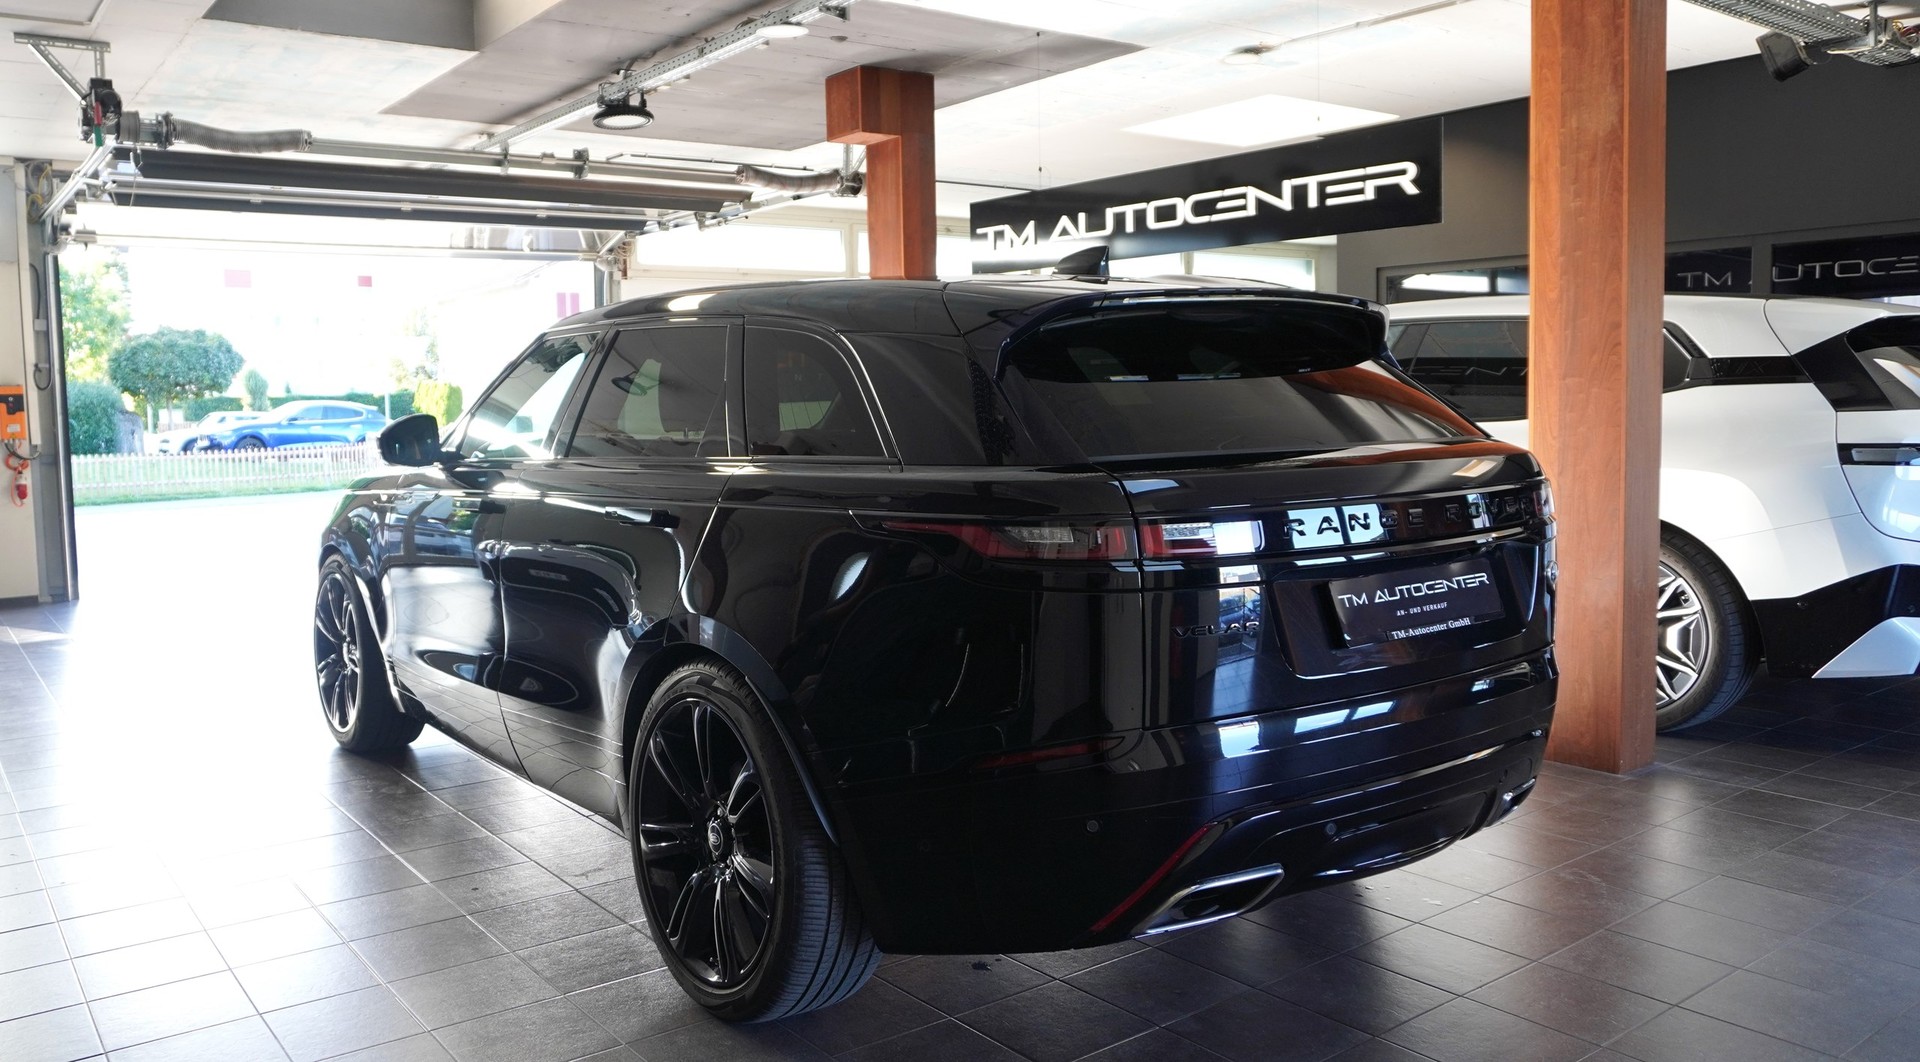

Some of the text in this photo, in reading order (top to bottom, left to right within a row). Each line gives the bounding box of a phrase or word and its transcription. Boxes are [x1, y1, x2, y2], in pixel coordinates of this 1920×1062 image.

[976, 161, 1420, 249] TM AUTOCENTER
[1677, 256, 1920, 288] TM UTOCE
[1283, 496, 1533, 539] RANGE ROVER
[1338, 573, 1489, 608] TM AUTOCENTER
[1396, 602, 1449, 617] AN- UND VERKAUF
[1171, 621, 1260, 639] VELAR
[1392, 617, 1471, 639] TM-Autocenter GmbH
